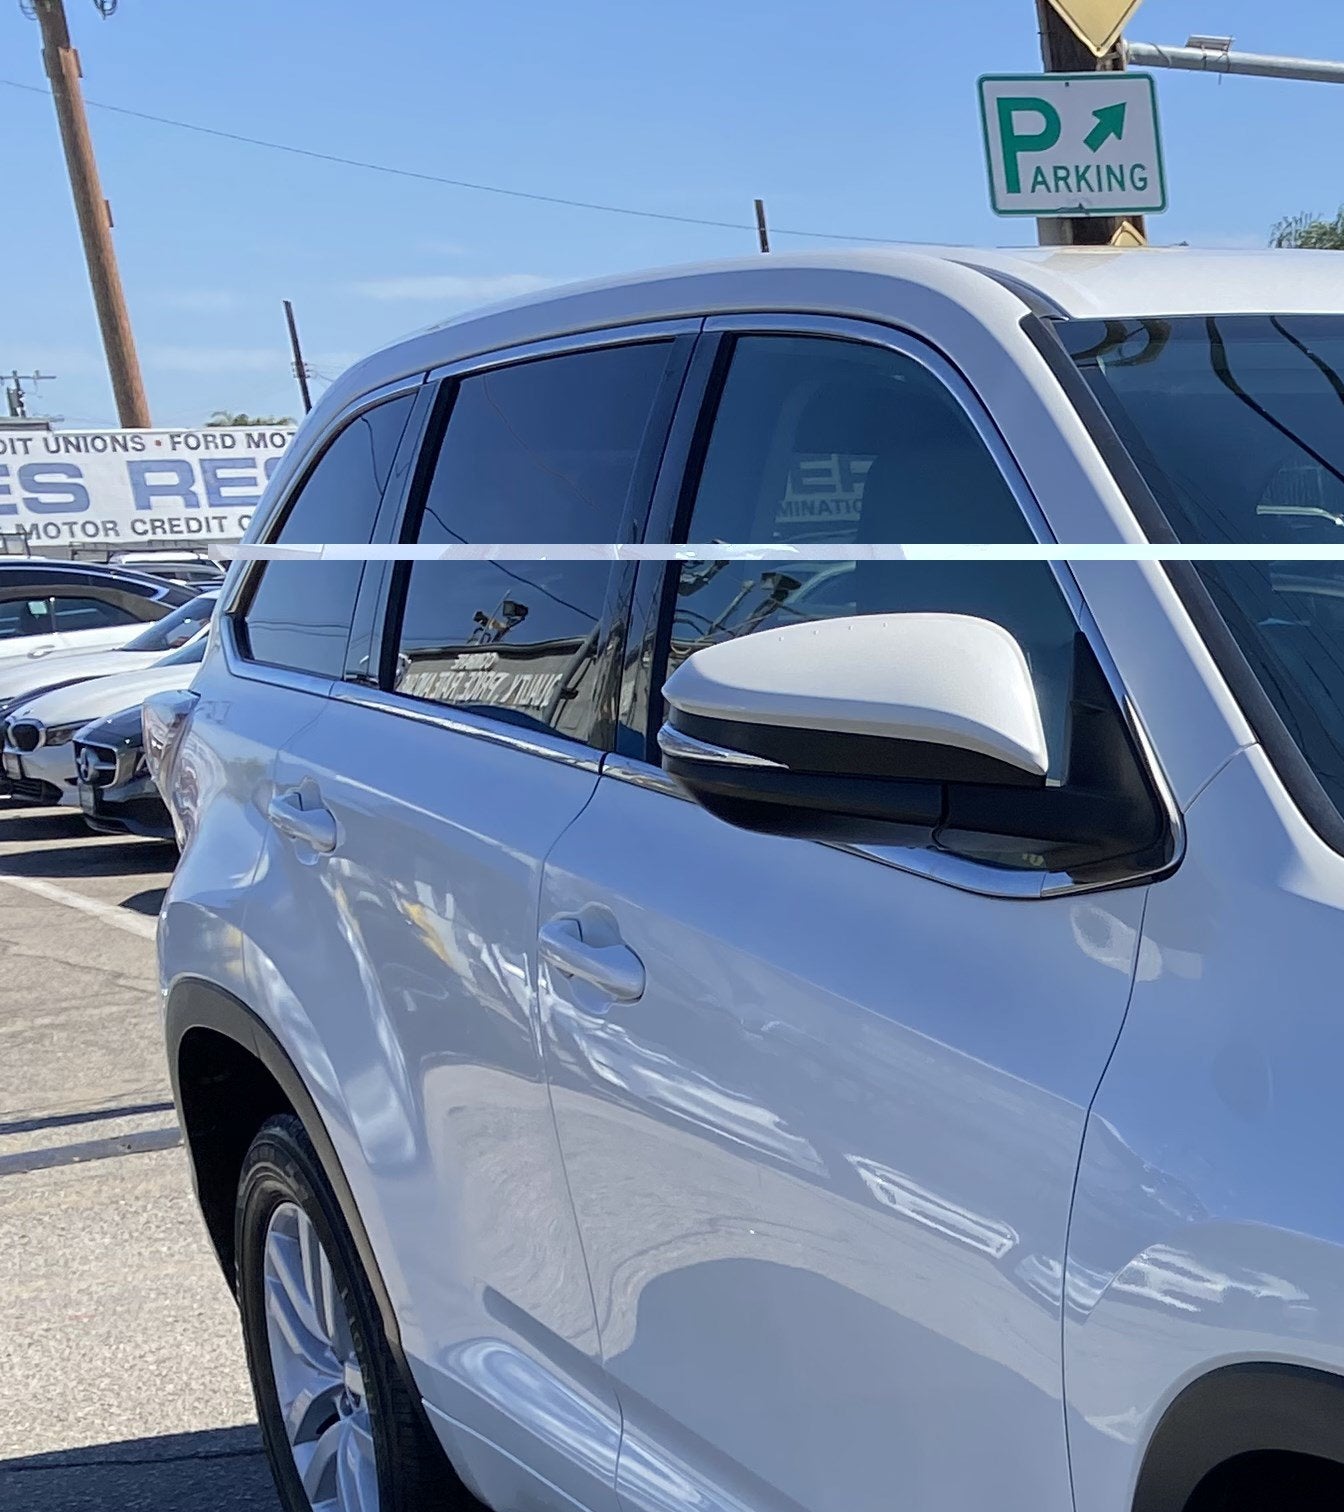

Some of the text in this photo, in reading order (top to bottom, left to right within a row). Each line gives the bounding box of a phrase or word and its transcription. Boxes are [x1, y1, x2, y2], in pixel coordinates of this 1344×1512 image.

[997, 97, 1148, 193] PARKING
[44, 435, 146, 454] UNIONS
[170, 432, 236, 451] FORD
[15, 520, 118, 541] MOTOR
[130, 516, 227, 535] CREDIT
